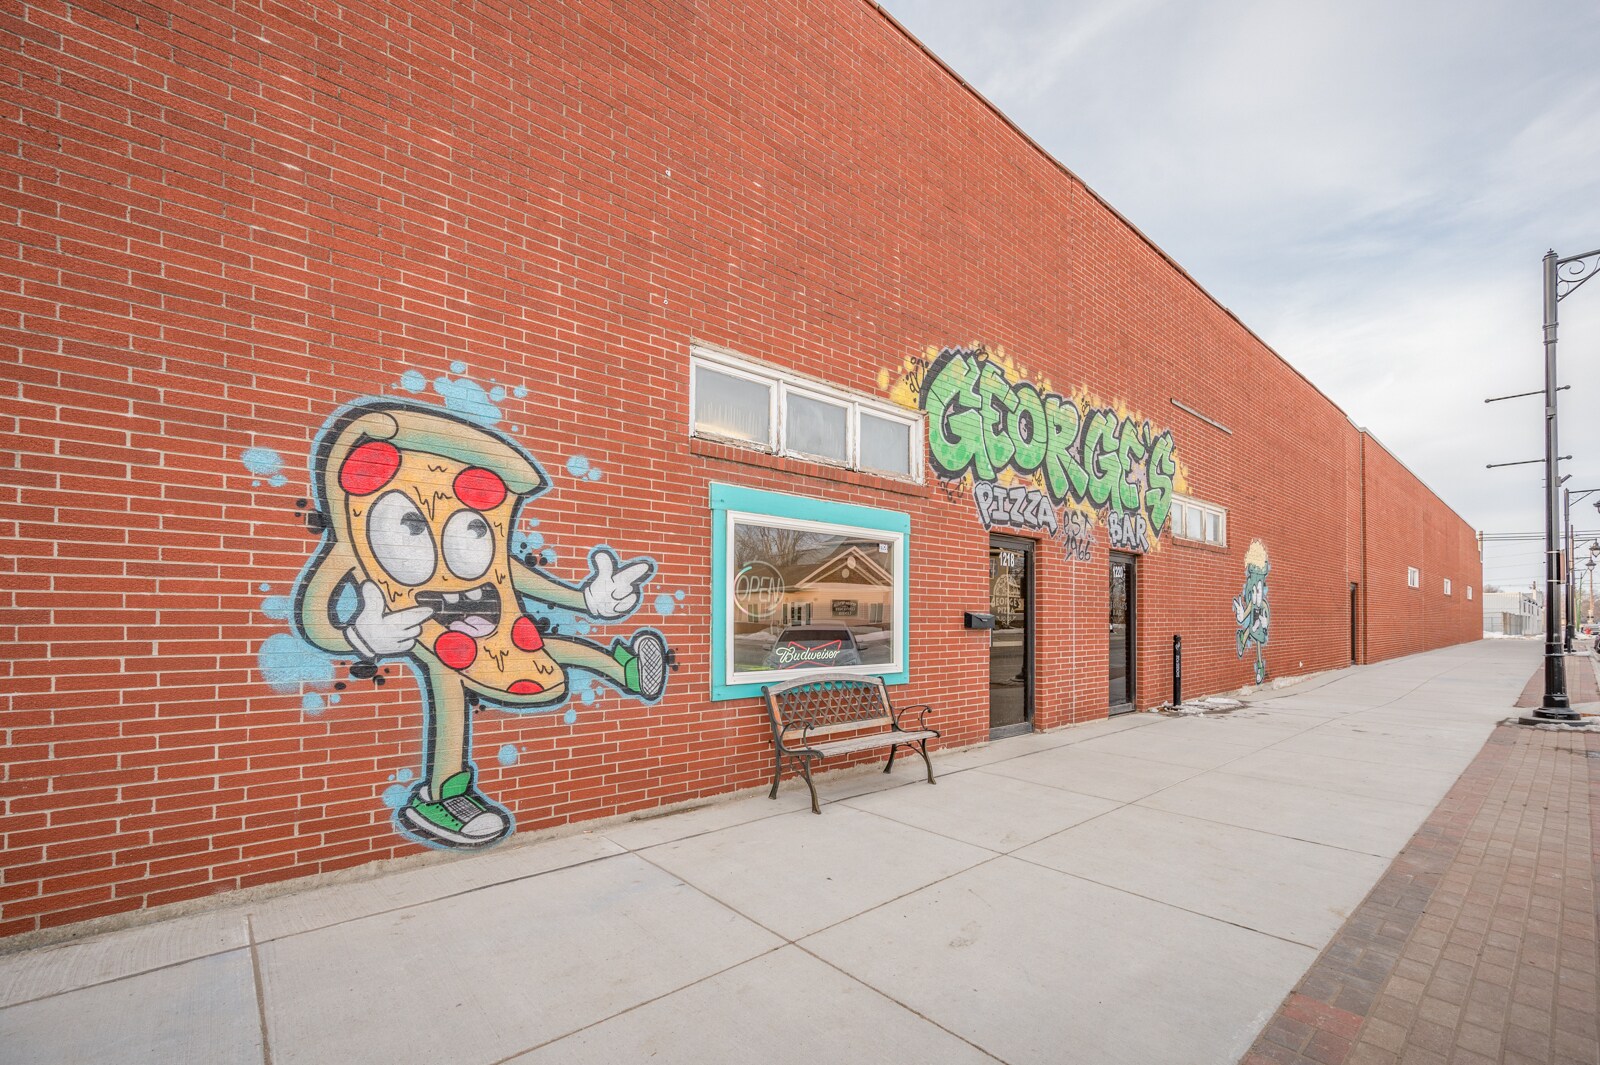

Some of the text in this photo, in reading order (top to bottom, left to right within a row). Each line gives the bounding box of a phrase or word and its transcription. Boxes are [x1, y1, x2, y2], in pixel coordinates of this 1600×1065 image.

[920, 346, 1176, 538] GEORGE'S
[974, 481, 1058, 537] PIZZA
[1108, 511, 1150, 552] BAR
[999, 552, 1015, 567] 1218
[1063, 535, 1091, 562] 1966
[736, 574, 781, 603] OPEN
[776, 646, 840, 664] Budweiser
